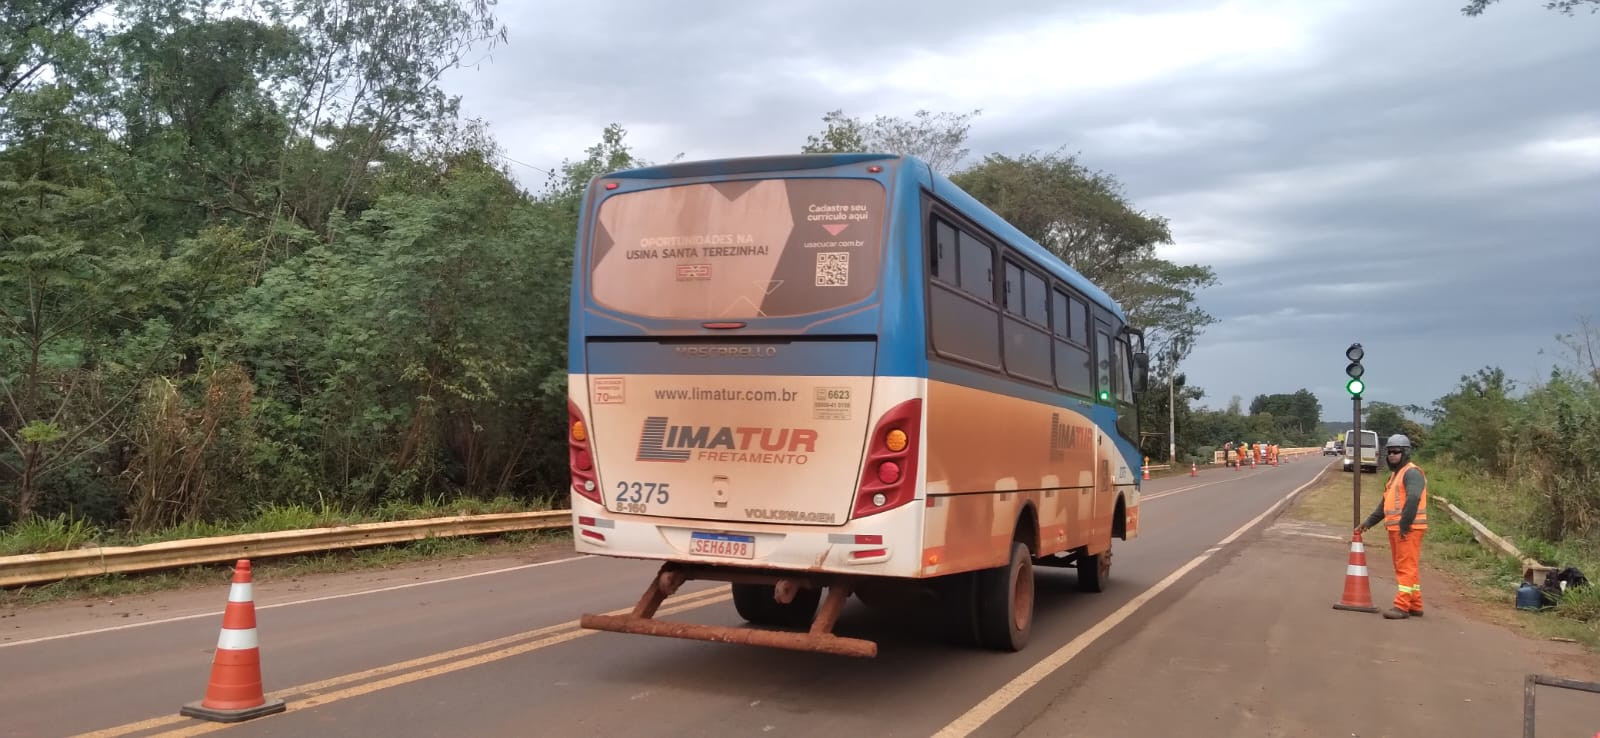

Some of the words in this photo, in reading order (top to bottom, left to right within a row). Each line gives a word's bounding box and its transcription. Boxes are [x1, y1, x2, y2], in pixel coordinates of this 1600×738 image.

[808, 204, 849, 213] Cadastre
[848, 211, 869, 222] aqui
[737, 234, 754, 244] NA
[626, 248, 658, 260] USINA
[661, 247, 699, 259] SANTA
[702, 245, 769, 257] TEREZINHA!
[654, 387, 798, 402] www.limatur.com.br
[828, 390, 850, 399] 6623
[635, 416, 818, 463] LIMATUR
[697, 451, 808, 465] FRETAMENTO
[616, 481, 670, 504] 2375
[616, 503, 647, 514] 8-160
[744, 508, 835, 523] VOLKSWAGEN
[695, 539, 747, 556] SEH6A98
